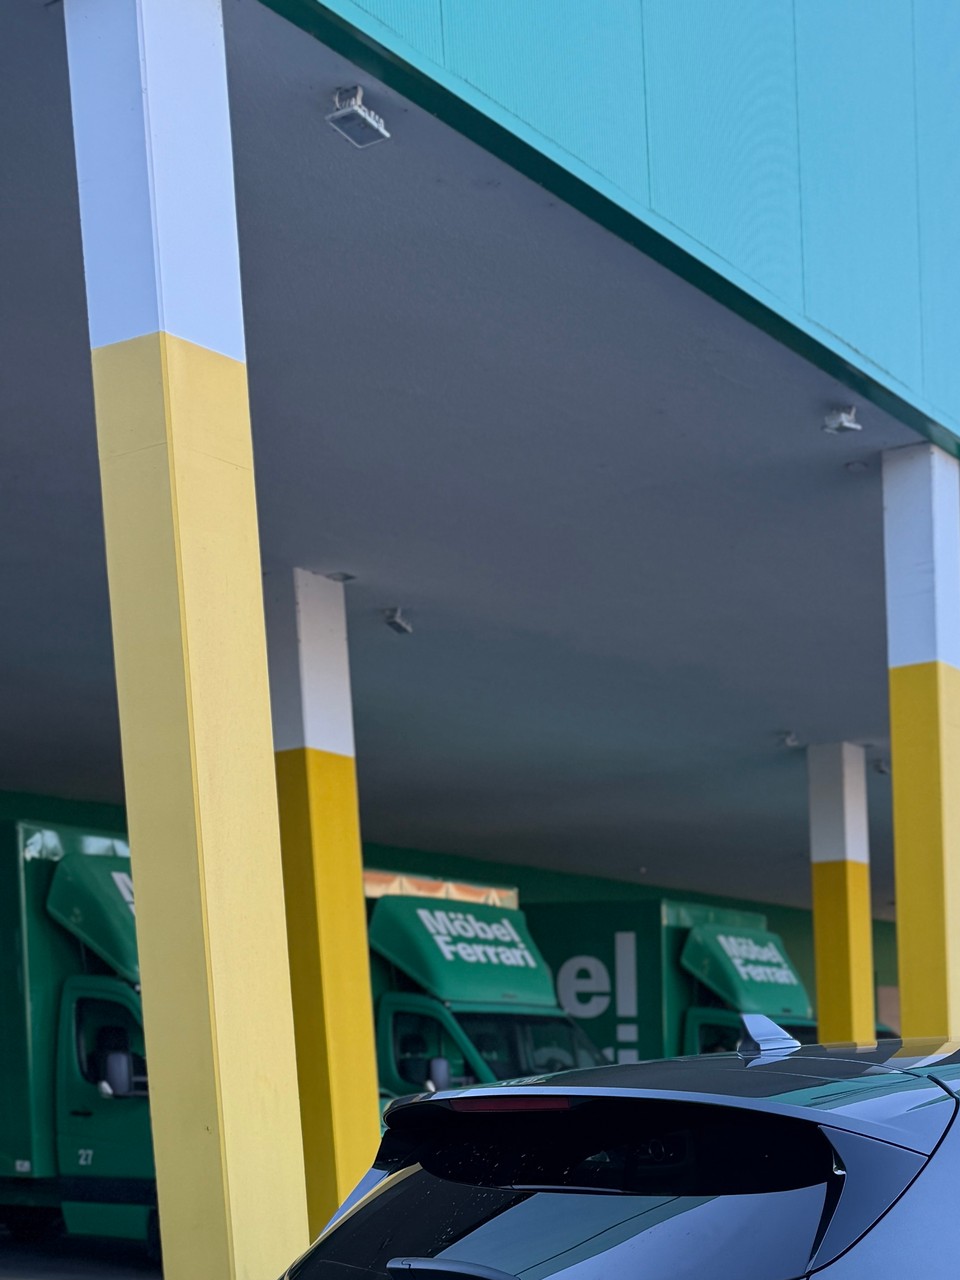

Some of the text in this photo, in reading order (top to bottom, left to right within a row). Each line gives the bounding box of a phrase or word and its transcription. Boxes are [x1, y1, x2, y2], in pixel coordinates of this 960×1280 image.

[416, 908, 521, 943] Möbel
[433, 935, 537, 968] Ferrari
[717, 934, 785, 964] Möbel
[733, 958, 799, 986] Ferrari
[78, 1149, 94, 1166] 27
